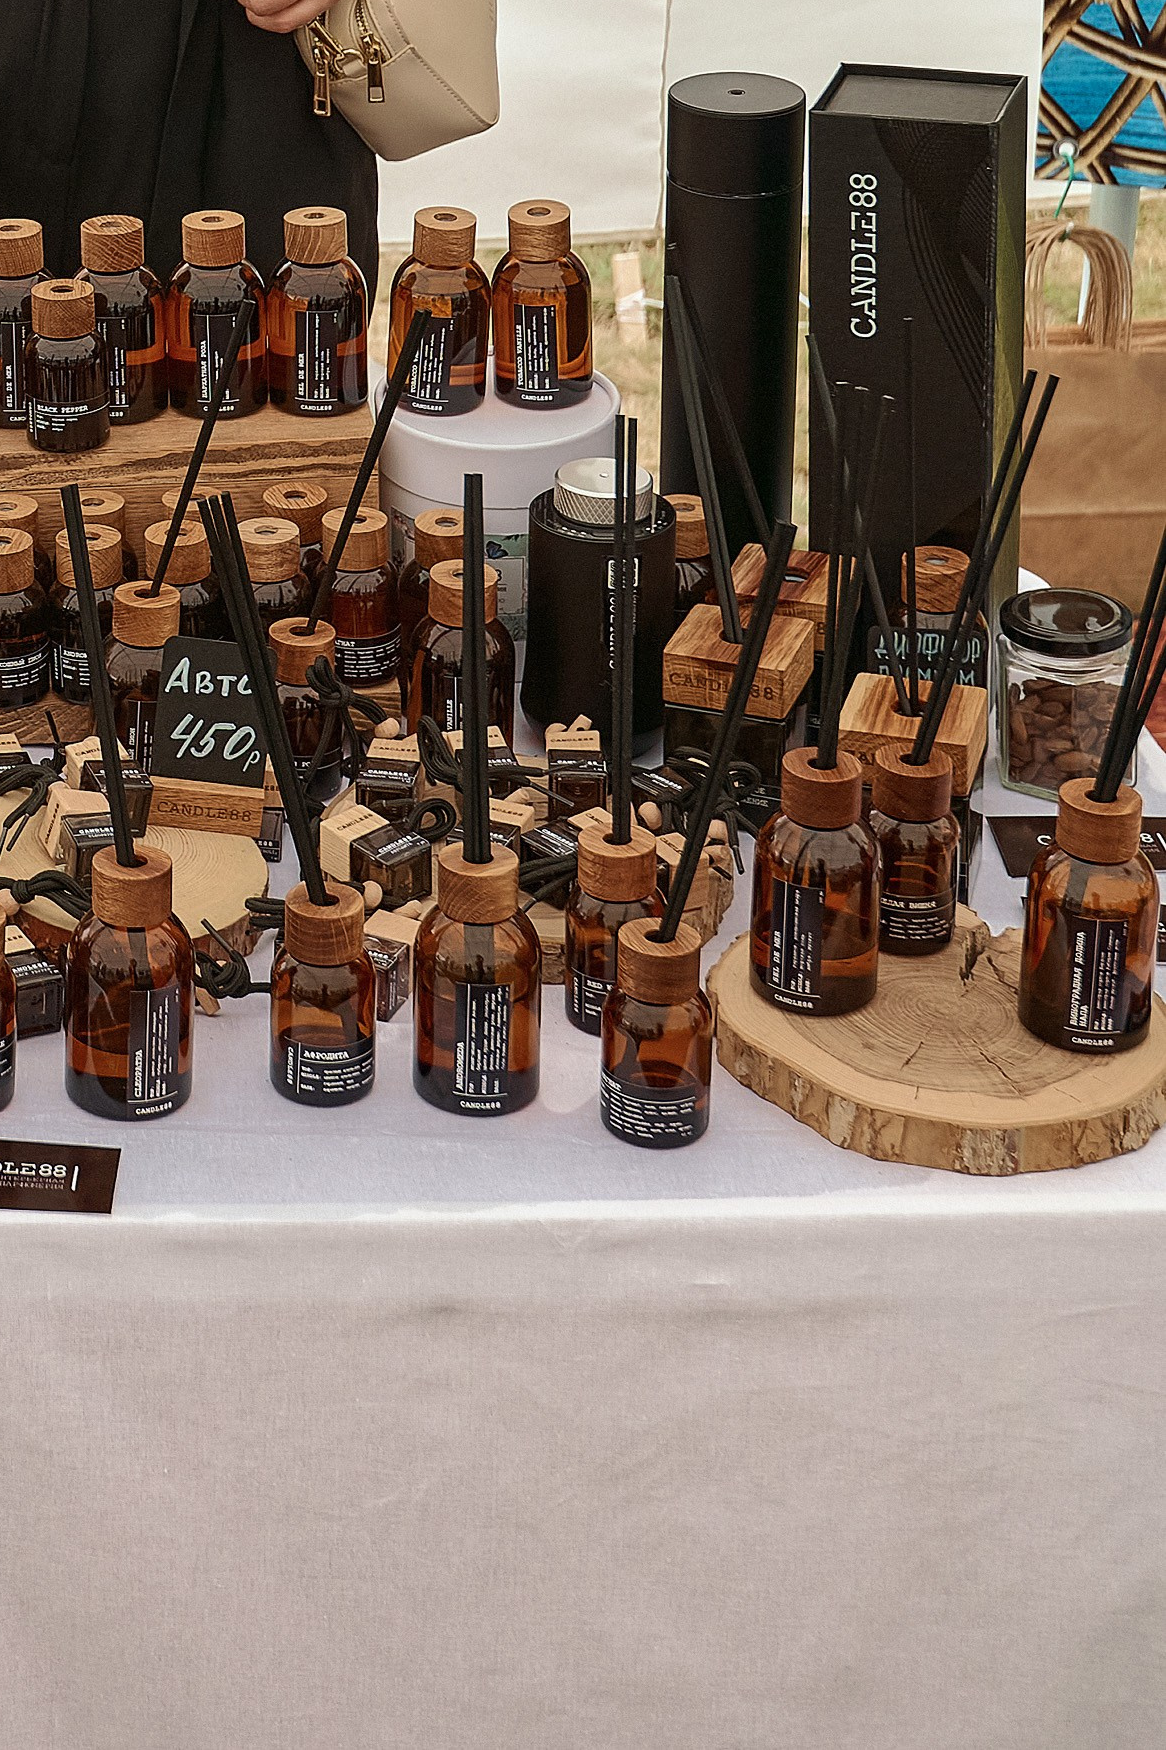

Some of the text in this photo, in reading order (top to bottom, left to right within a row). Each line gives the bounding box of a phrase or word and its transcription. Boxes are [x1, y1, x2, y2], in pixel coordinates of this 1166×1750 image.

[848, 173, 878, 339] CANDLE88
[516, 356, 524, 386] TOBACCO
[61, 405, 88, 413] PEPPER
[170, 713, 261, 772] 450р
[157, 801, 252, 822] CANDLE88
[336, 813, 373, 831] CANDLE88
[773, 950, 780, 964] DE
[586, 979, 603, 989] RED
[772, 966, 780, 984] SEL
[1069, 931, 1087, 1026] ВИНОГРАДНАЯ ДОЛИНА
[1078, 1005, 1088, 1028] НАПА
[286, 1046, 294, 1085] CANDLE88
[303, 1050, 350, 1060] АФРОДИТА
[134, 1050, 143, 1098] CLEOPATRA
[456, 1041, 465, 1091] ANDROMEDA
[135, 1102, 173, 1115] CANDLE88
[459, 1100, 501, 1110] CANDLE88
